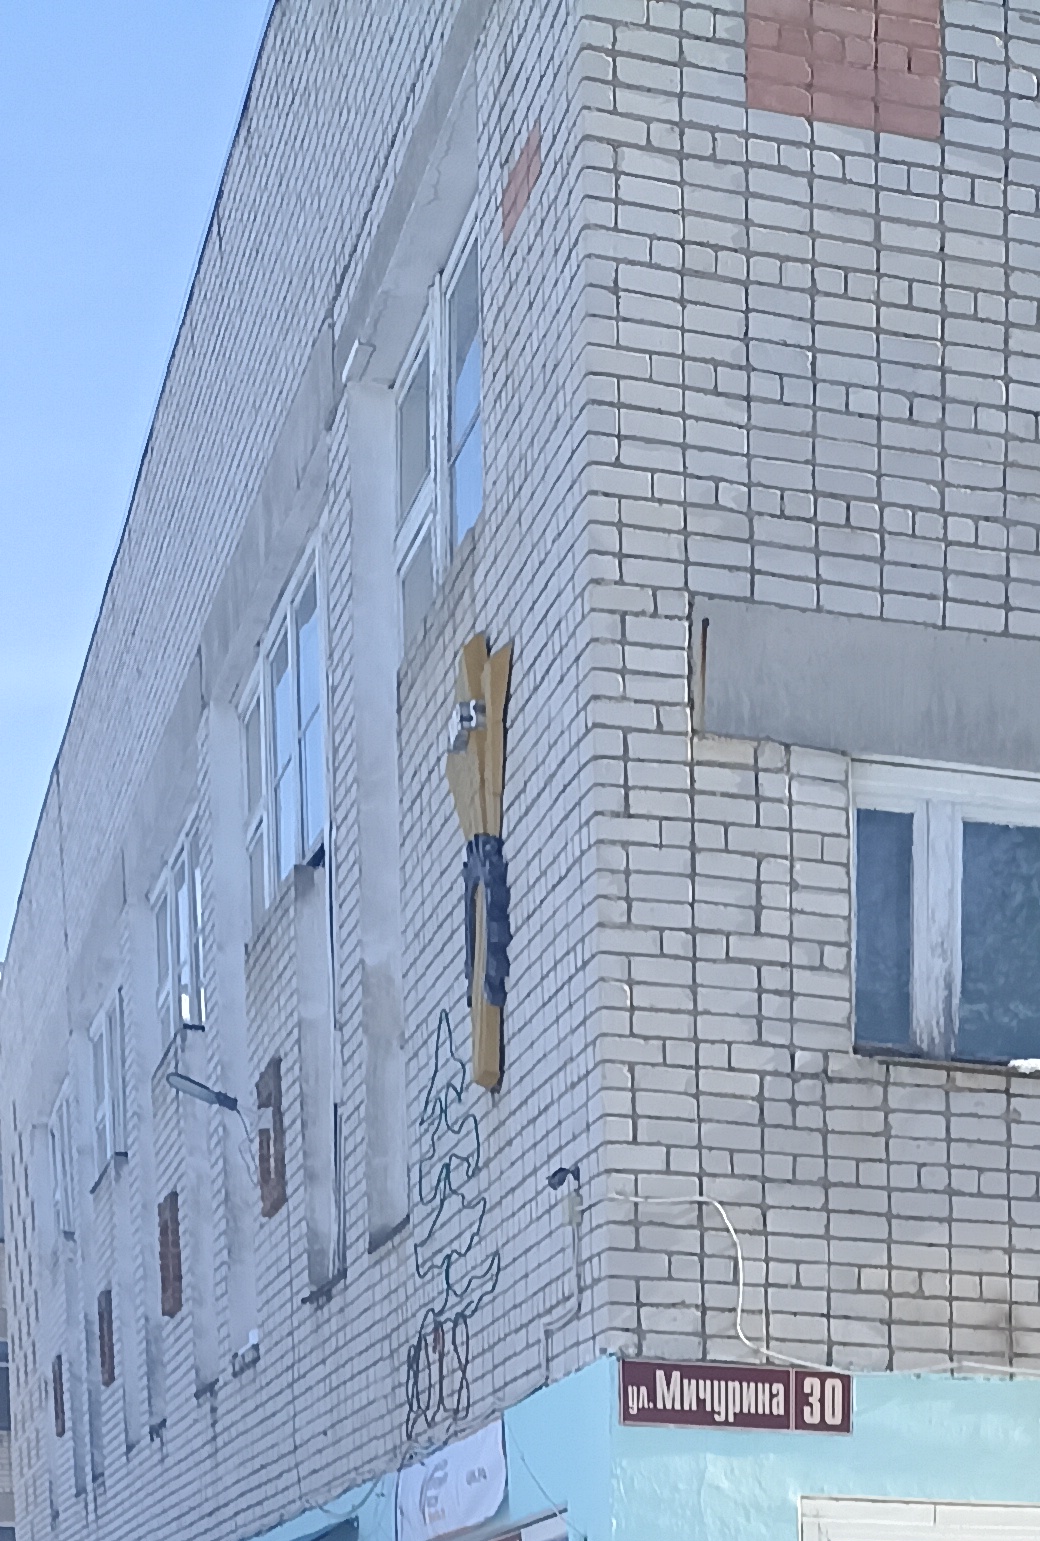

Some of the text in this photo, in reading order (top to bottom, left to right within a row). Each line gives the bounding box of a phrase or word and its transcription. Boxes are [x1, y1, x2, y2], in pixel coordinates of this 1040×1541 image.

[627, 1369, 843, 1425] ул. Мичурина 30
